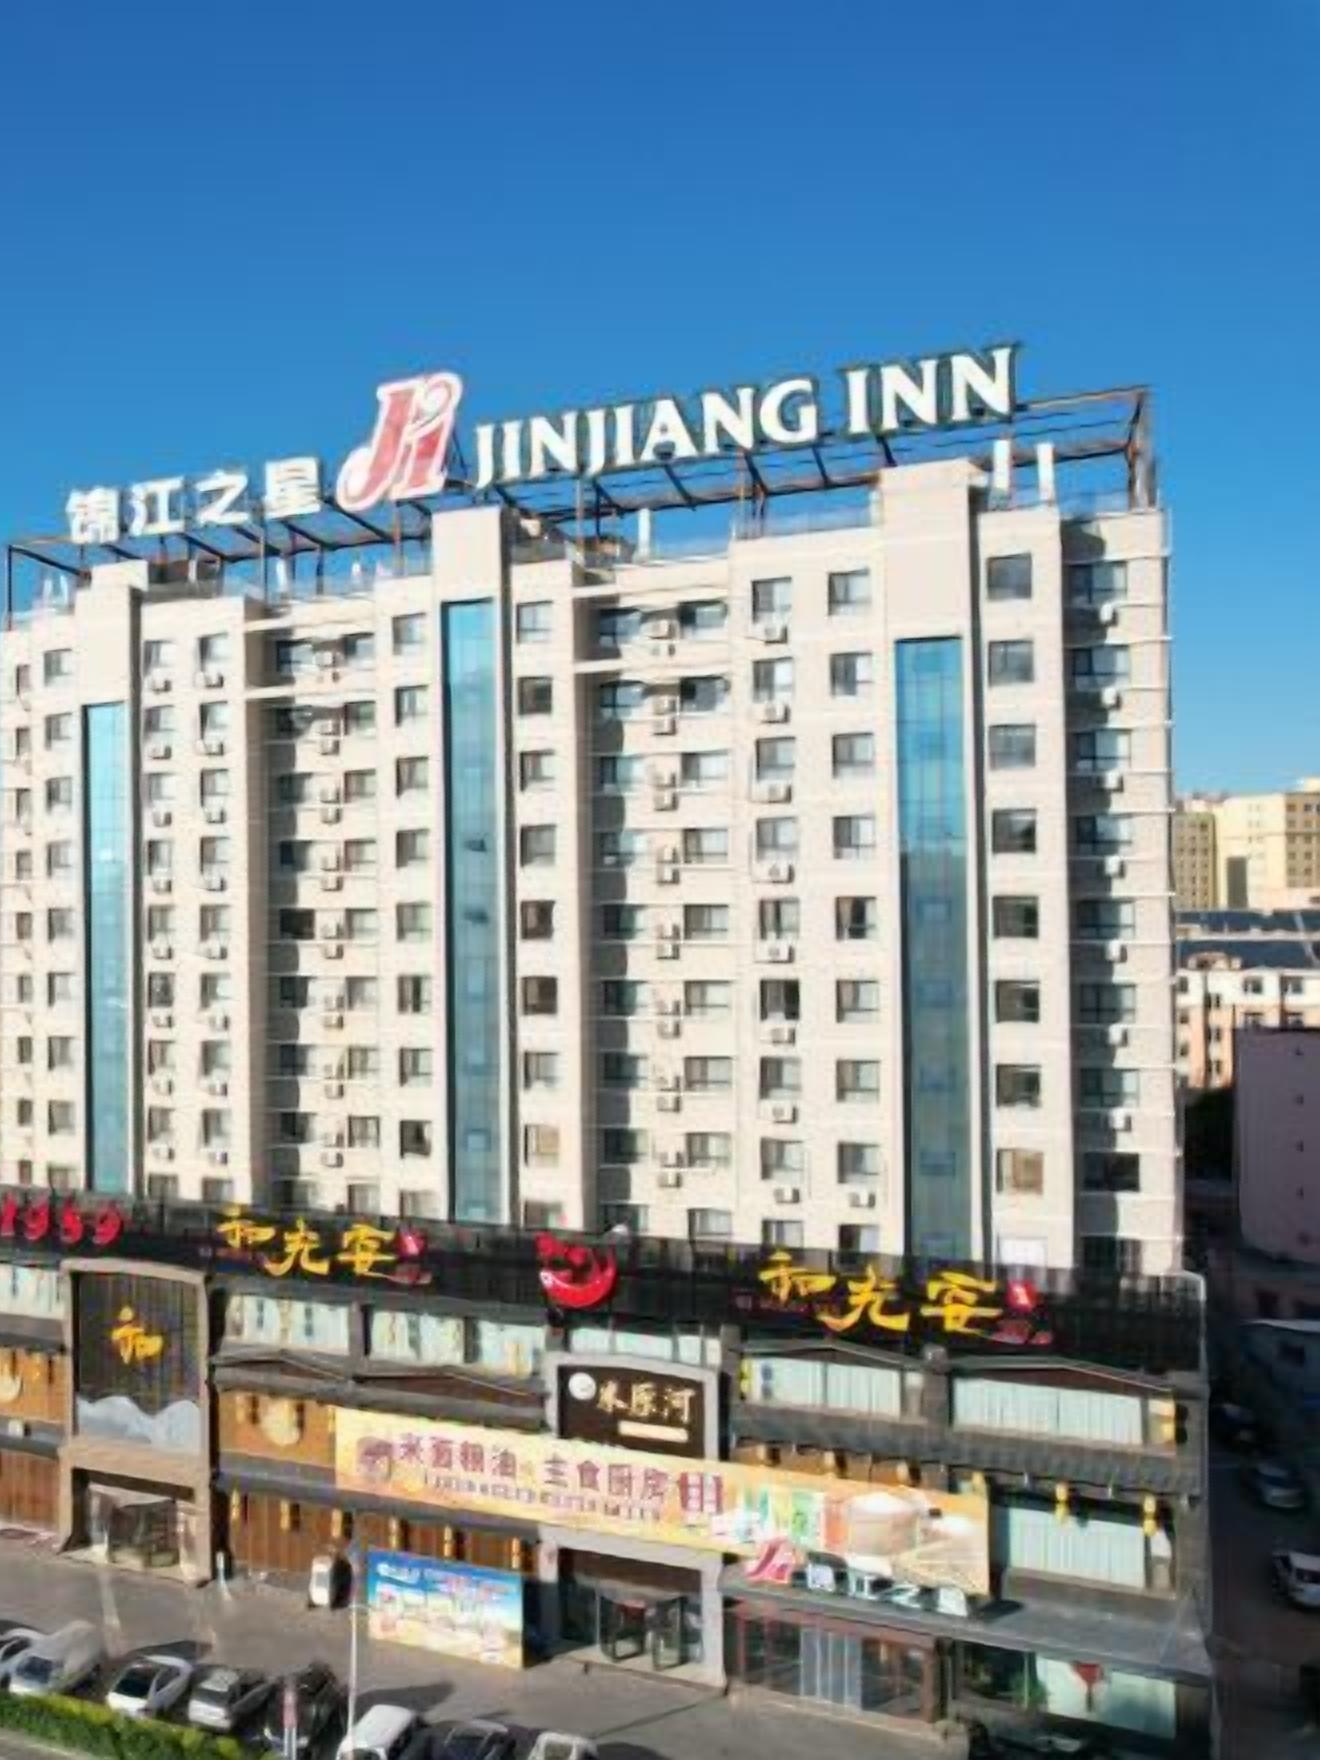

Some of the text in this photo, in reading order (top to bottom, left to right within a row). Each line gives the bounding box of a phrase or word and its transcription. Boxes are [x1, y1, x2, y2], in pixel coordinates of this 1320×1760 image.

[476, 345, 1014, 490] JINJIANG INN
[66, 457, 321, 543] 锦江之星
